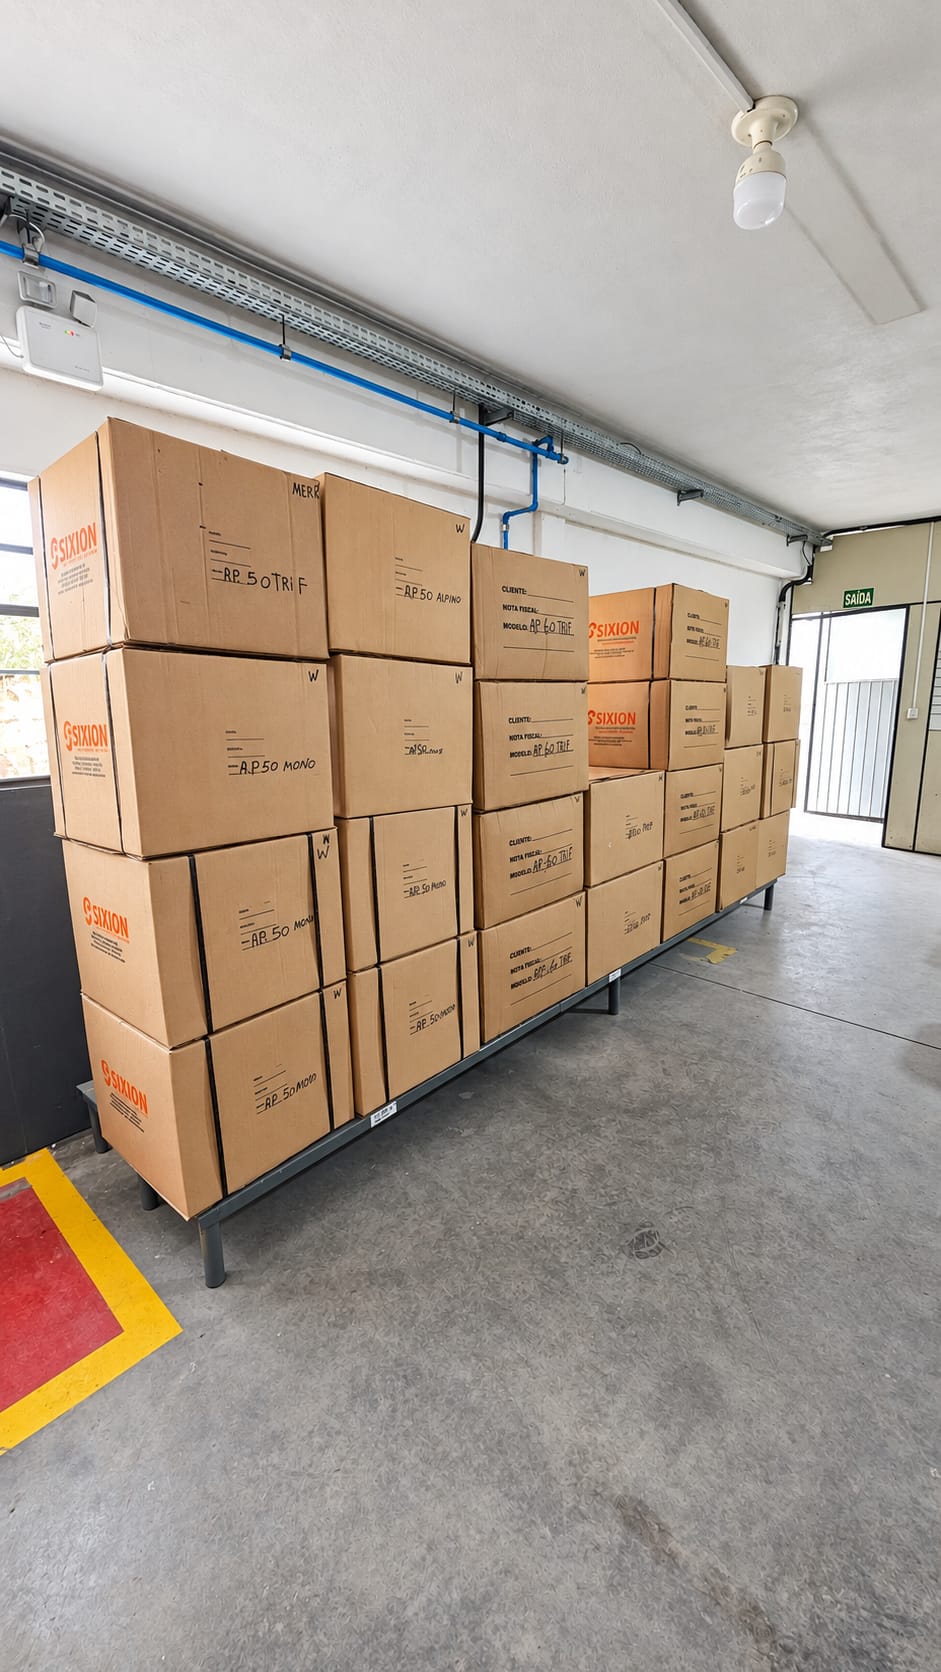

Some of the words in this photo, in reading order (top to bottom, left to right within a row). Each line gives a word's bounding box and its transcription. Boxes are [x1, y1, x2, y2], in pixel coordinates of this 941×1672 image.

[455, 523, 465, 533] W
[59, 522, 97, 562] SIXION
[501, 585, 527, 595] CLIENTE:
[436, 592, 461, 604] ALPINO
[845, 590, 871, 606] SAÍDA
[597, 620, 640, 638] SIXION
[308, 669, 319, 682] W
[596, 712, 636, 725] SIXION
[72, 724, 108, 747] SIXION
[283, 758, 316, 772] MONO
[317, 845, 330, 860] W
[92, 905, 129, 938] SIXION
[272, 926, 290, 941] 50
[111, 1070, 148, 1114] SIXION
